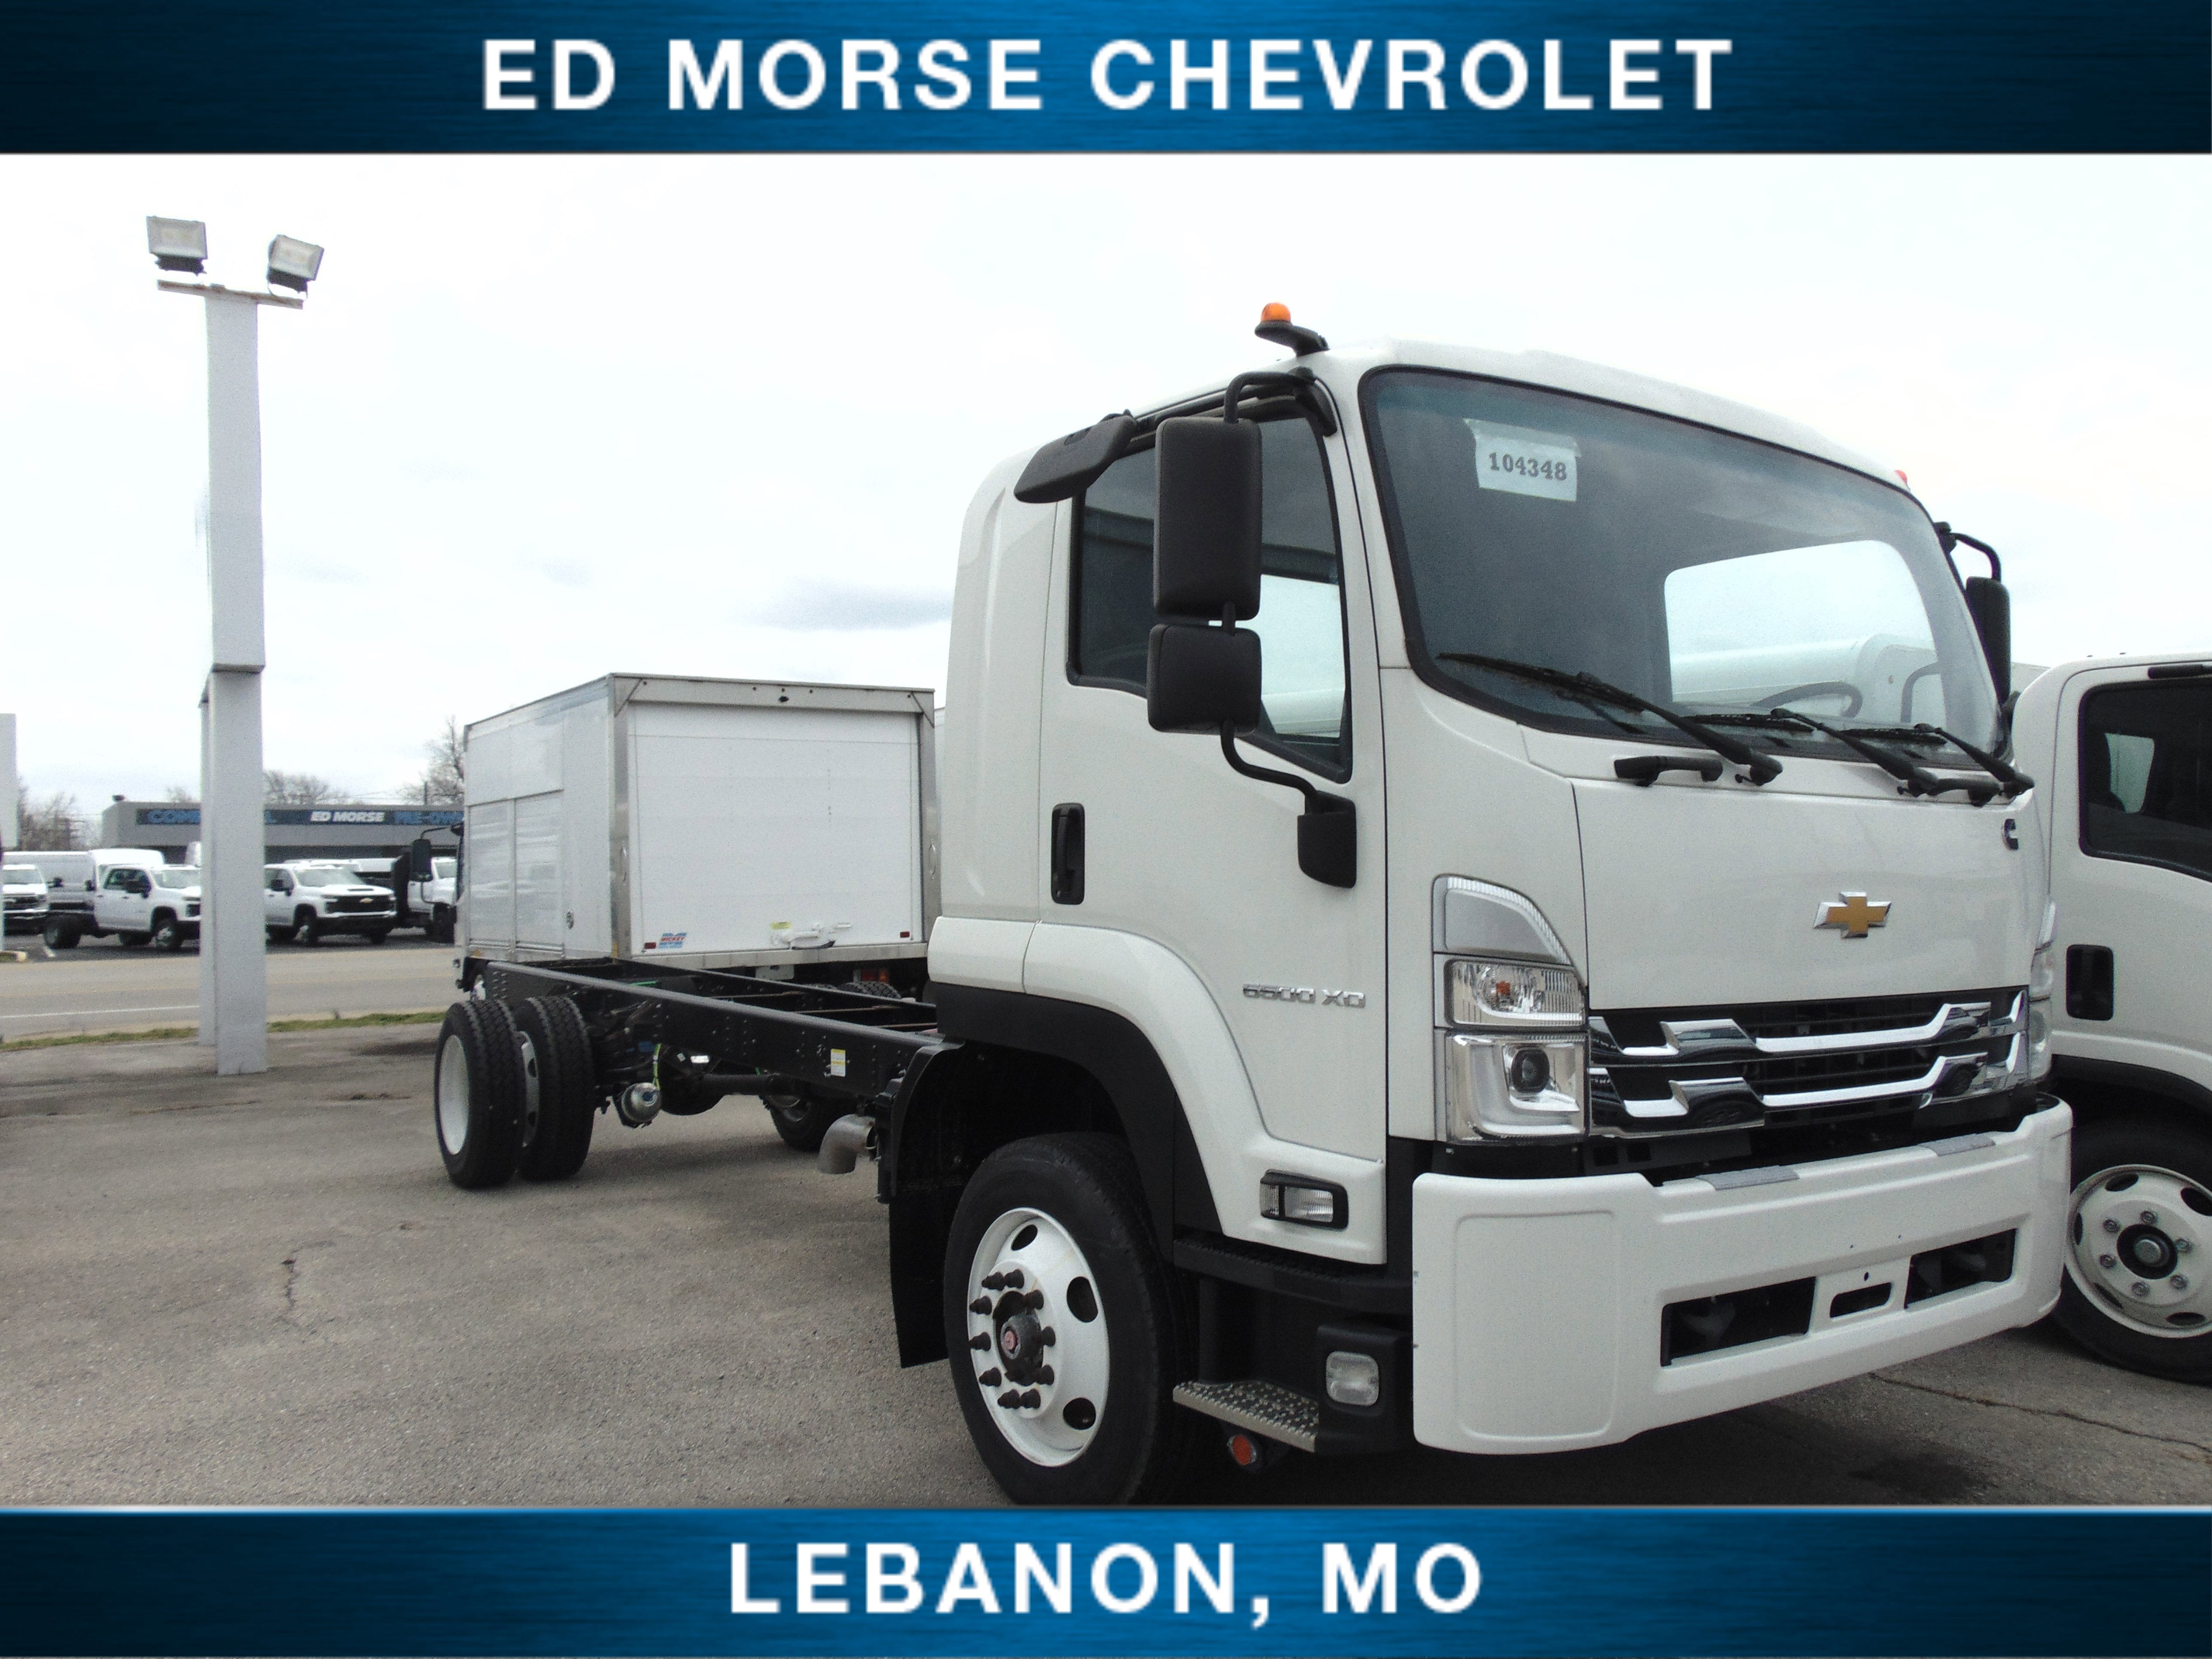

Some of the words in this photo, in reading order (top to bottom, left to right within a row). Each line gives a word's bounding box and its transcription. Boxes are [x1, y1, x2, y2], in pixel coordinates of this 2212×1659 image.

[1489, 452, 1567, 481] 104348
[310, 811, 331, 822] ED
[332, 811, 385, 822] MORSE
